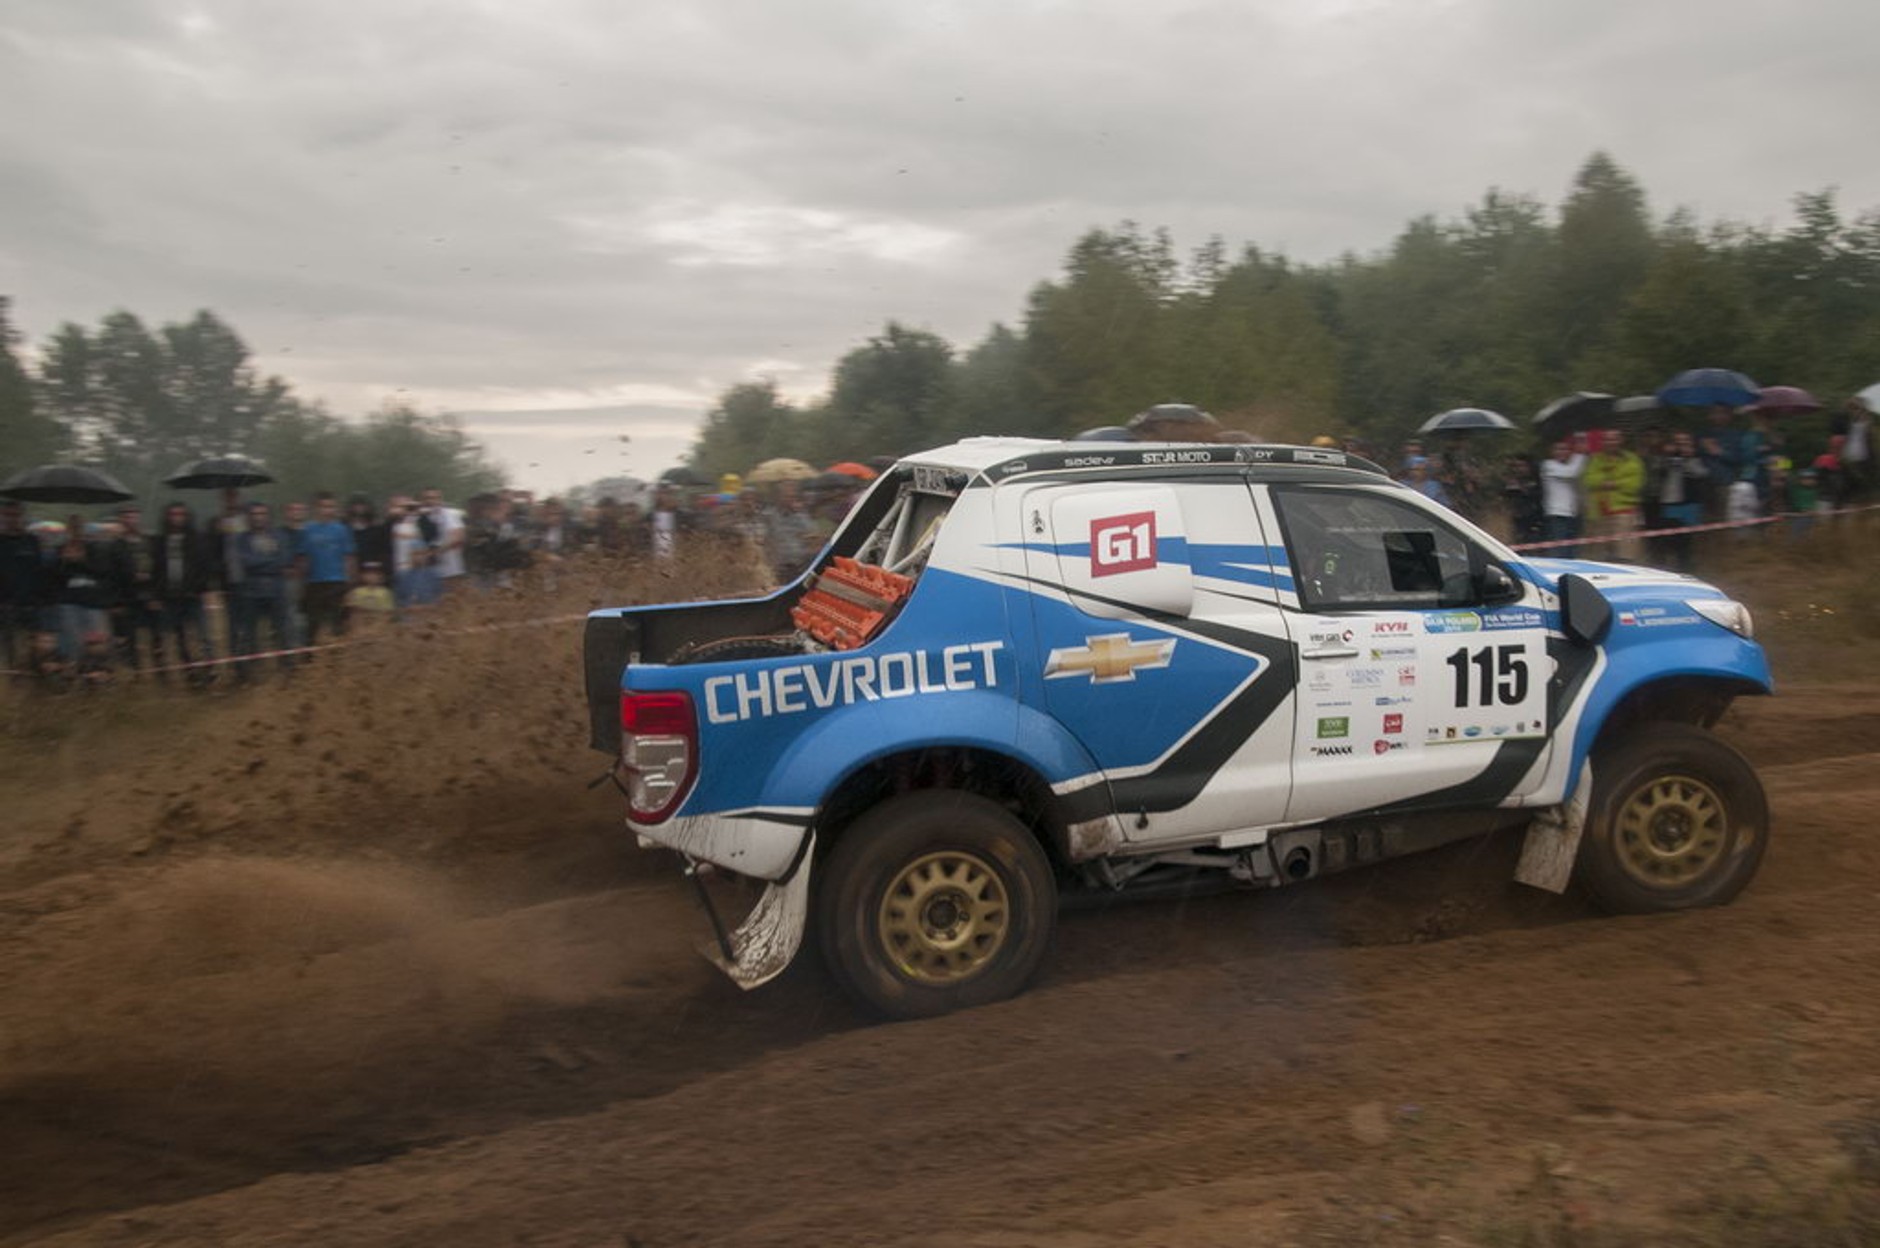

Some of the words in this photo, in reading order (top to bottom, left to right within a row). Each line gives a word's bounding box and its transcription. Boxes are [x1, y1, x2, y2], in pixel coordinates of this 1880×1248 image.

[1177, 451, 1212, 462] MOTO
[1098, 522, 1151, 565] G1
[704, 641, 1004, 724] CHEVROLET
[1446, 644, 1528, 707] 115
